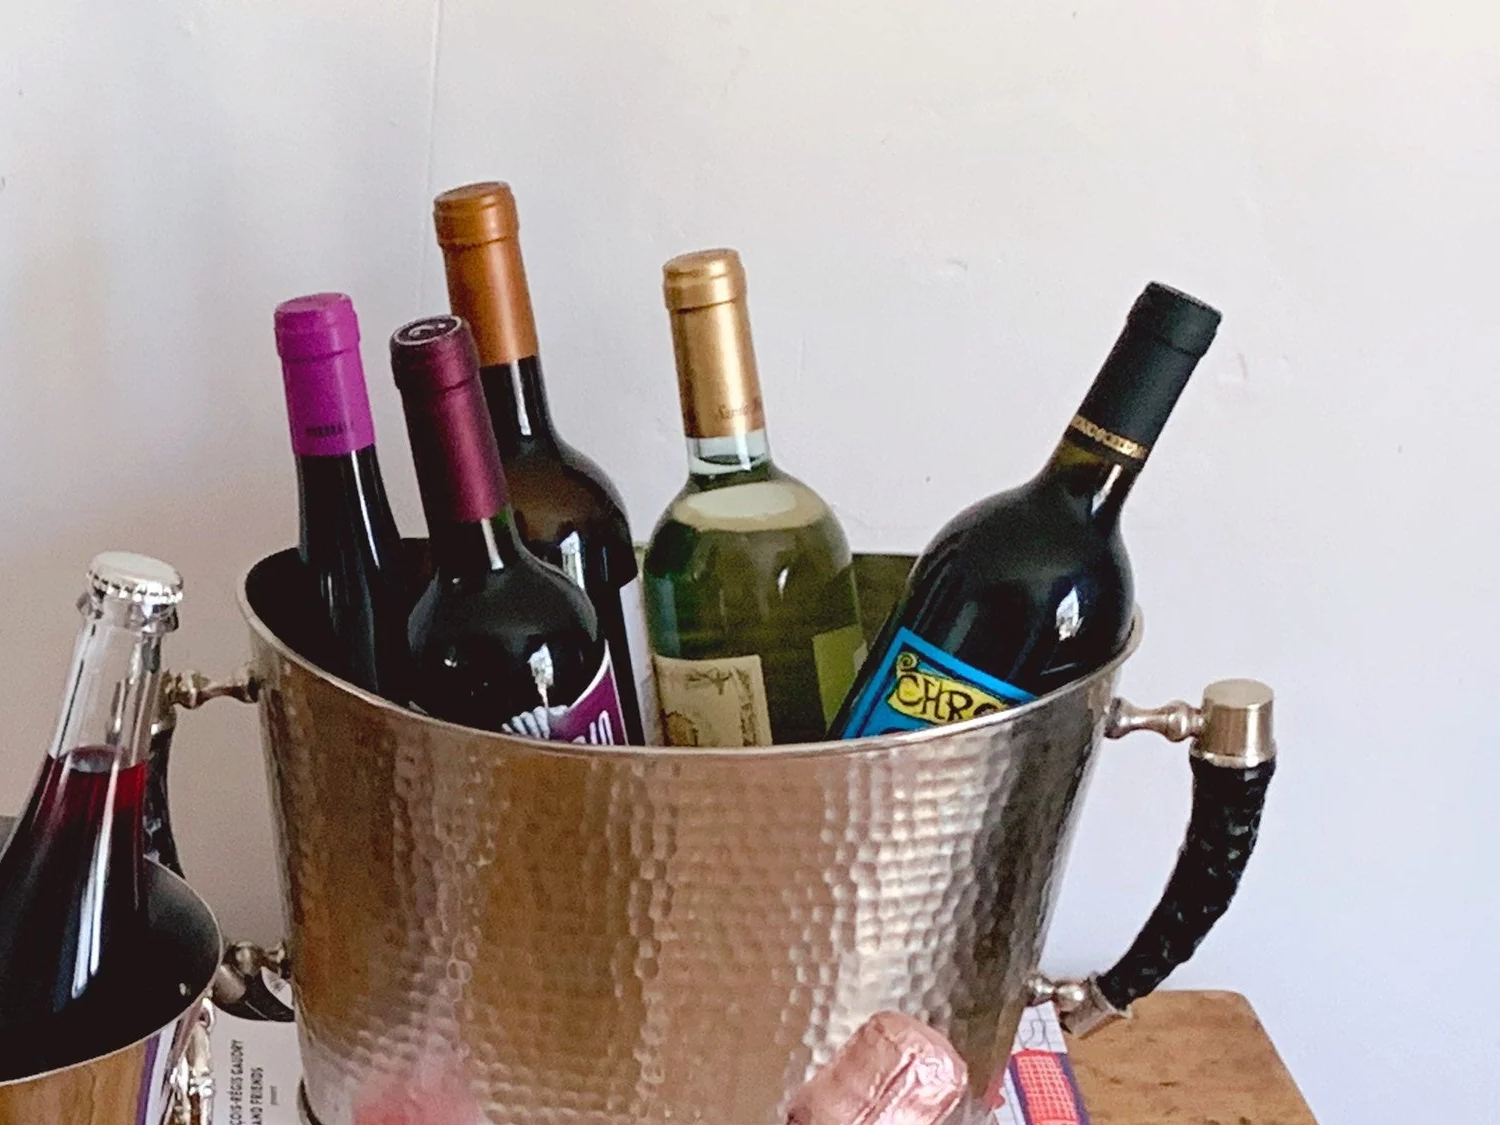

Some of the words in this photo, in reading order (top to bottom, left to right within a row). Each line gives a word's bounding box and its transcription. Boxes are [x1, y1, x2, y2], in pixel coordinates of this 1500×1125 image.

[230, 1039, 244, 1075] GAUDRY
[250, 1067, 264, 1105] FRIENDS
[251, 1107, 263, 1125] AND
